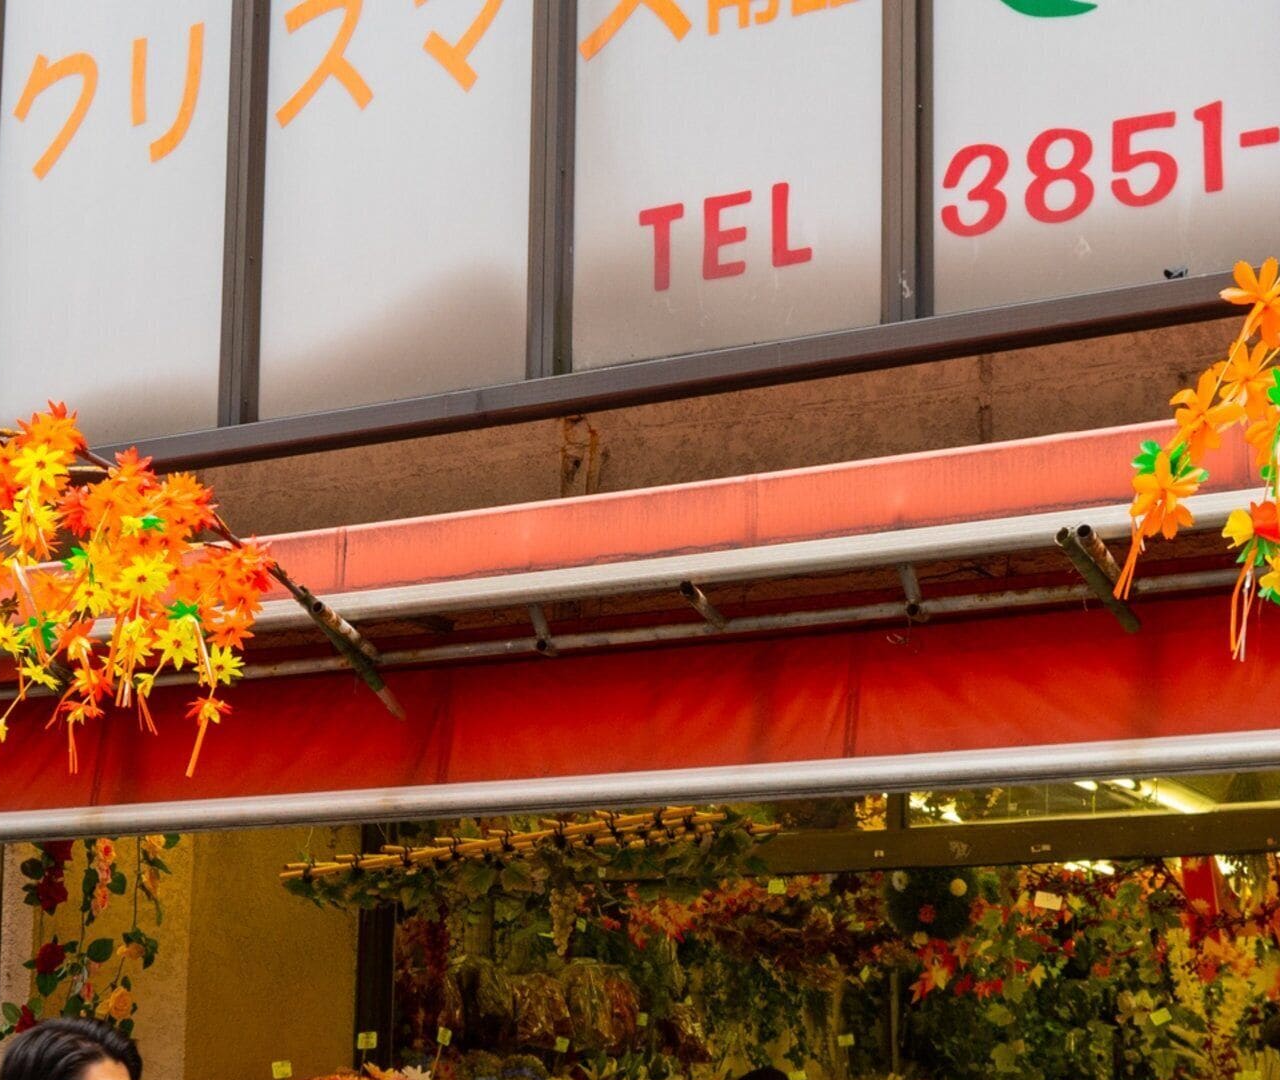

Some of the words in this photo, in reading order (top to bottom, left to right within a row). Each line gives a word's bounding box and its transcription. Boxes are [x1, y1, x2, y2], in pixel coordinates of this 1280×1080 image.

[14, 0, 867, 181] クリスマ
[639, 182, 812, 292] TEL
